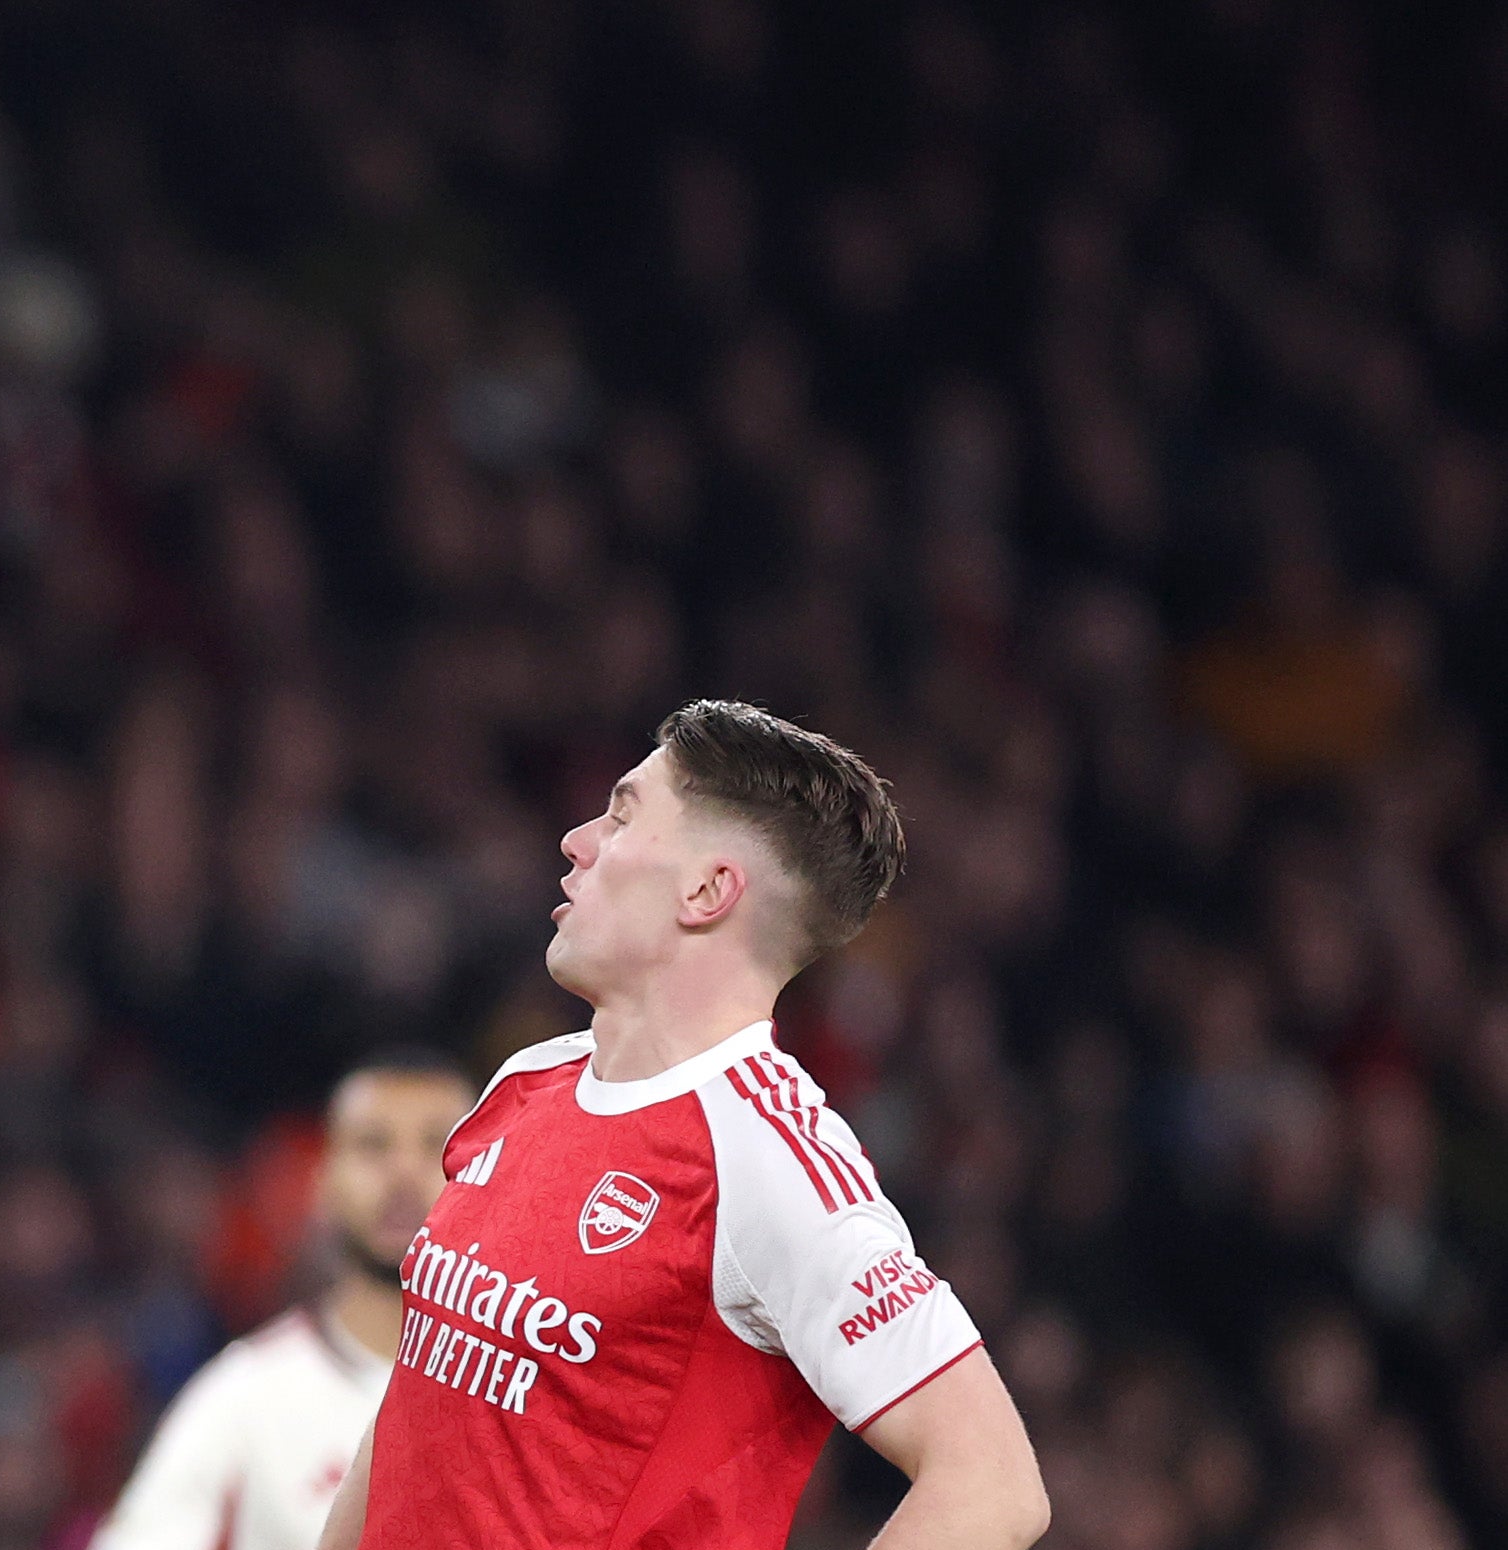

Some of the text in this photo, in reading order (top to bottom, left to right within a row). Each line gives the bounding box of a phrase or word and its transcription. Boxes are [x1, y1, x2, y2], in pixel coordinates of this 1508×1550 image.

[602, 1183, 649, 1216] Arsenal
[399, 1225, 603, 1364] Emirates
[838, 1270, 939, 1347] RWAND
[851, 1249, 913, 1299] VISIT
[397, 1306, 540, 1415] FLY BETTER
